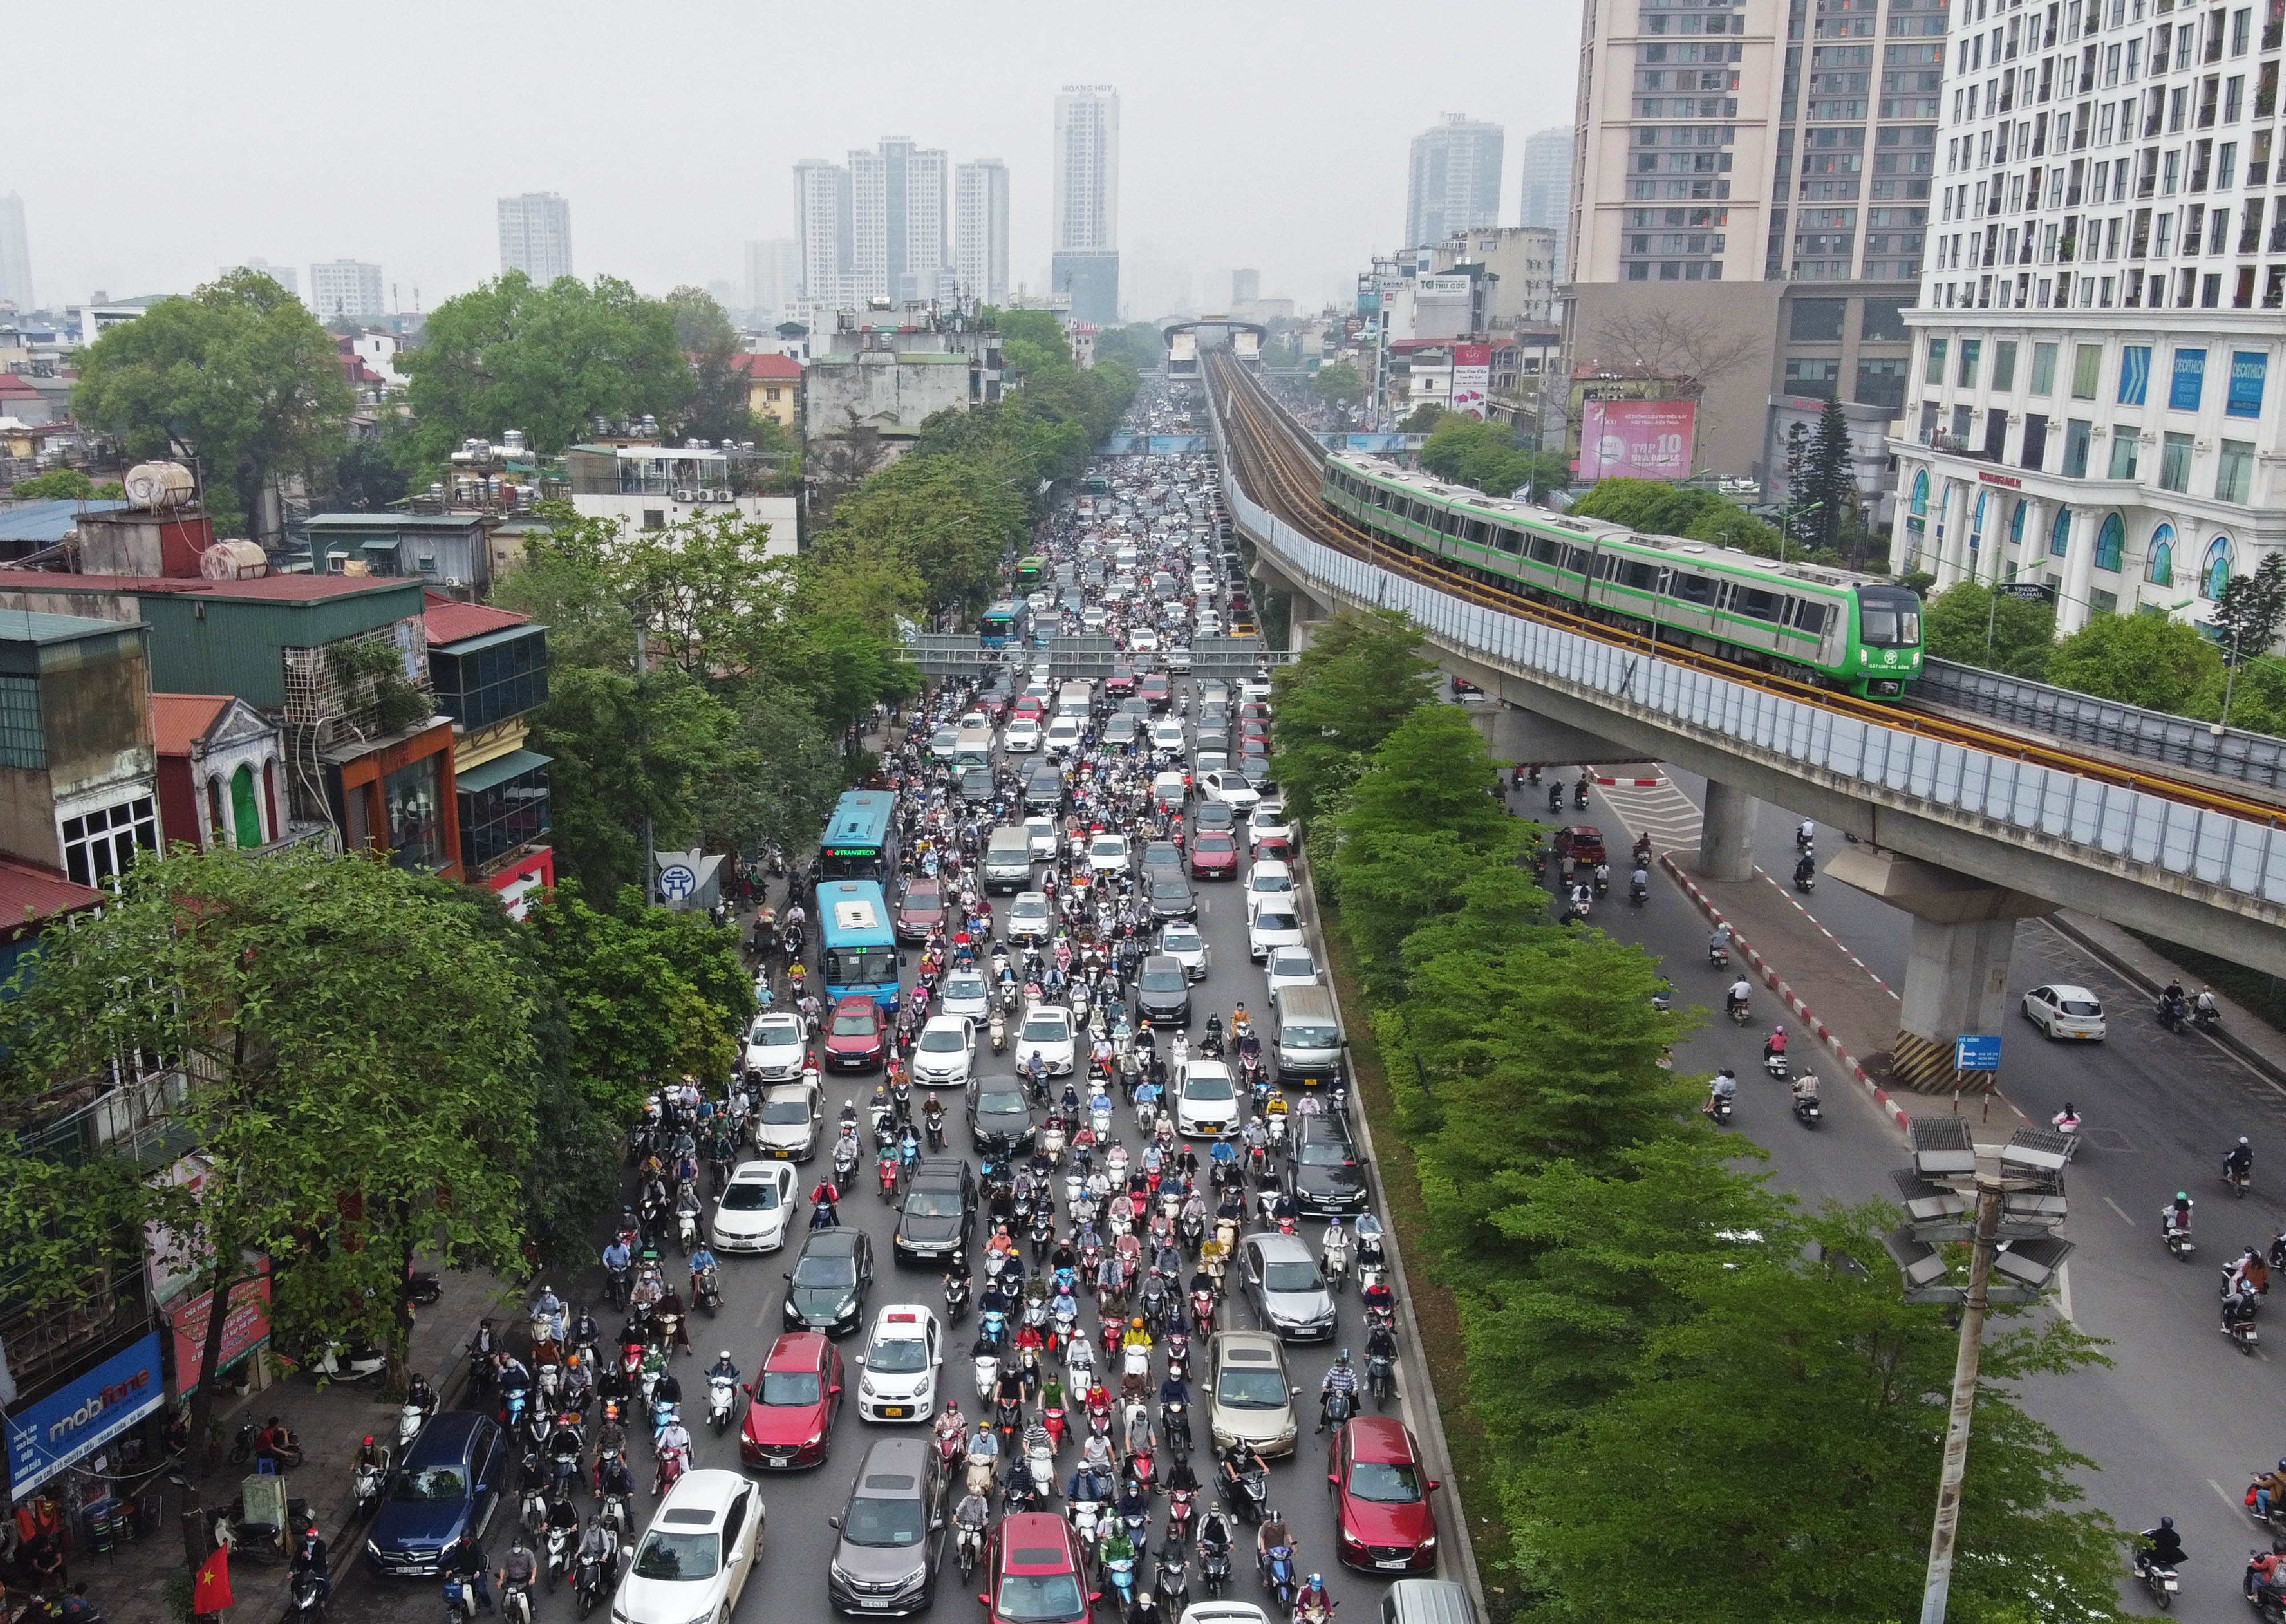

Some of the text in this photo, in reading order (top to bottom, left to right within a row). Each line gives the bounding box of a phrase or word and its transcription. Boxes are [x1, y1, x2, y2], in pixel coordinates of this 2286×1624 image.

[1095, 84, 1112, 92] HUY
[1658, 434, 1682, 453] 10
[50, 1369, 150, 1443] mobifone
